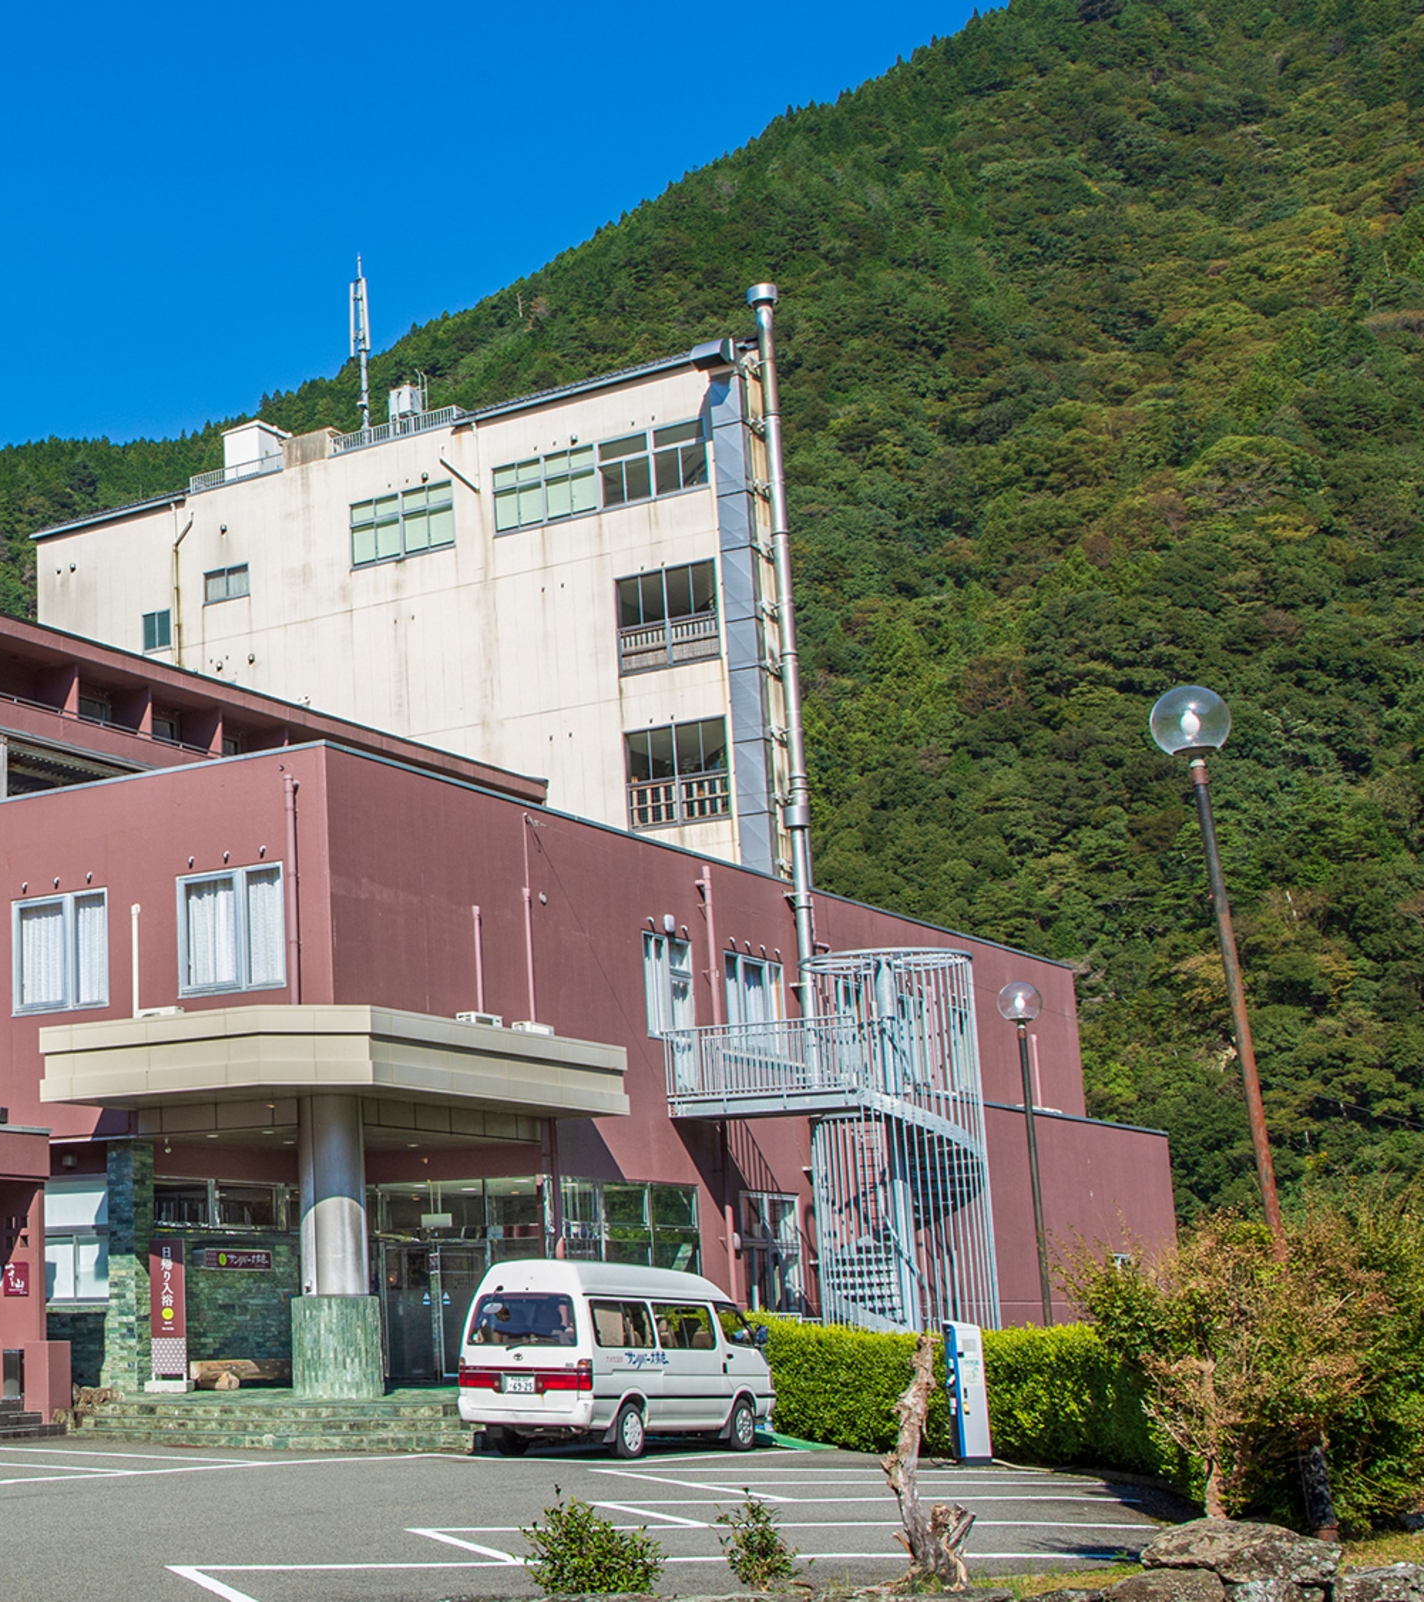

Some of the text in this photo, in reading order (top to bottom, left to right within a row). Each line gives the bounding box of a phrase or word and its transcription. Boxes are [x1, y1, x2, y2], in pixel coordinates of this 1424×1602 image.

[160, 1246, 174, 1307] 日帰り入浴
